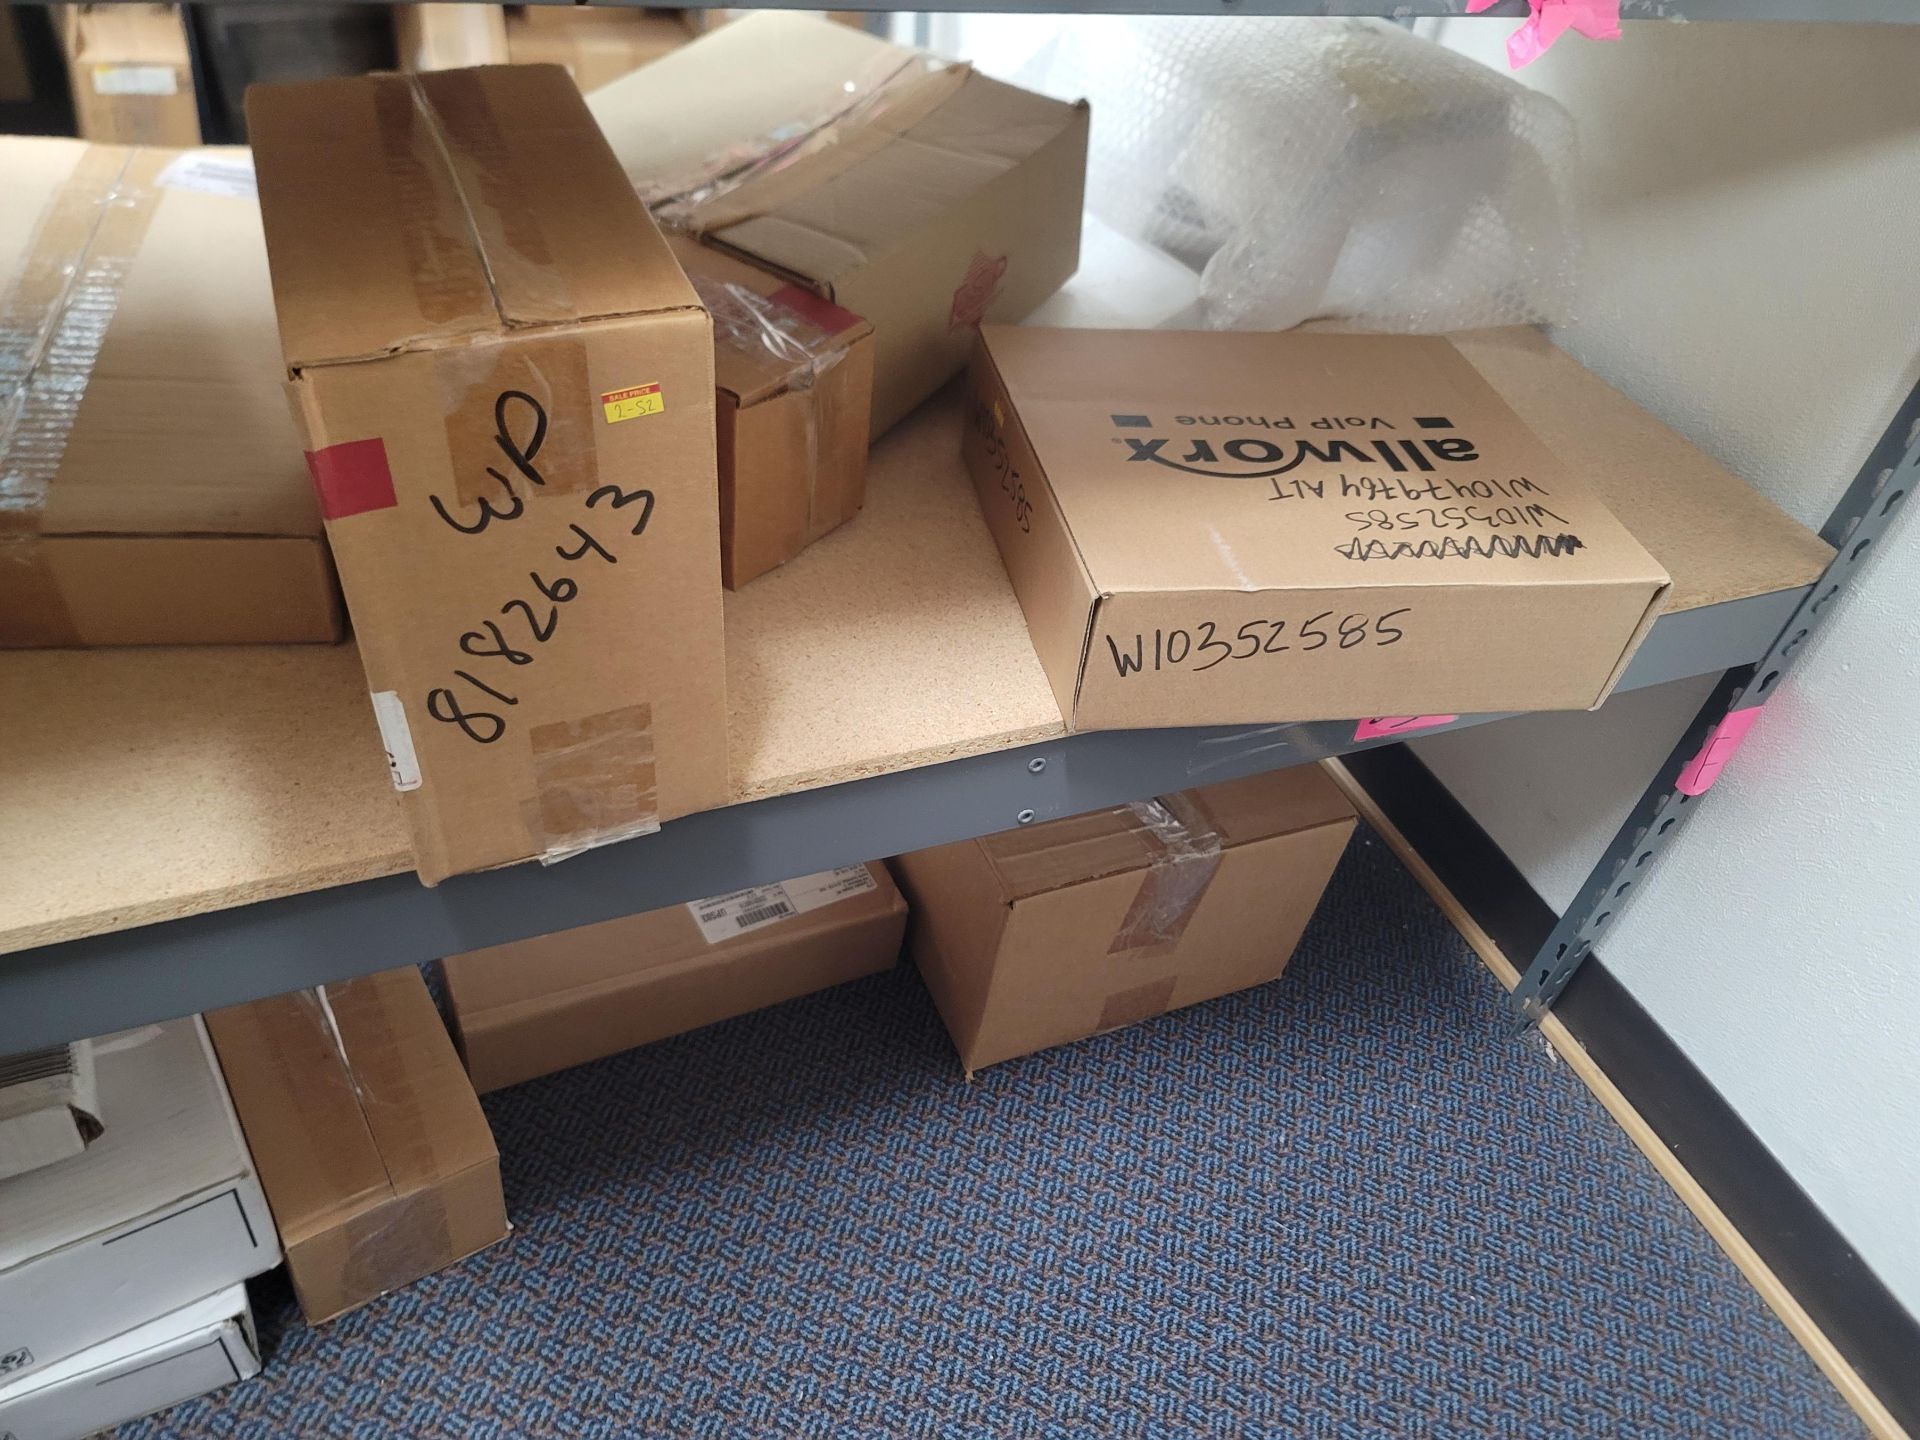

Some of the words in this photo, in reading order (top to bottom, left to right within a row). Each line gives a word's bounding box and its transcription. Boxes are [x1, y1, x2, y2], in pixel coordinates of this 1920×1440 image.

[609, 392, 629, 401] SALE
[630, 387, 650, 397] PRICE
[1174, 415, 1296, 430] Phone
[1311, 416, 1396, 430] VoIP
[429, 390, 547, 534] WP
[1124, 438, 1480, 478] allworx
[1267, 477, 1324, 501] ALT
[1339, 474, 1550, 501] W10479764
[1345, 503, 1569, 531] W10352585
[427, 484, 655, 743] 8182643
[1106, 608, 1411, 677] W10352585
